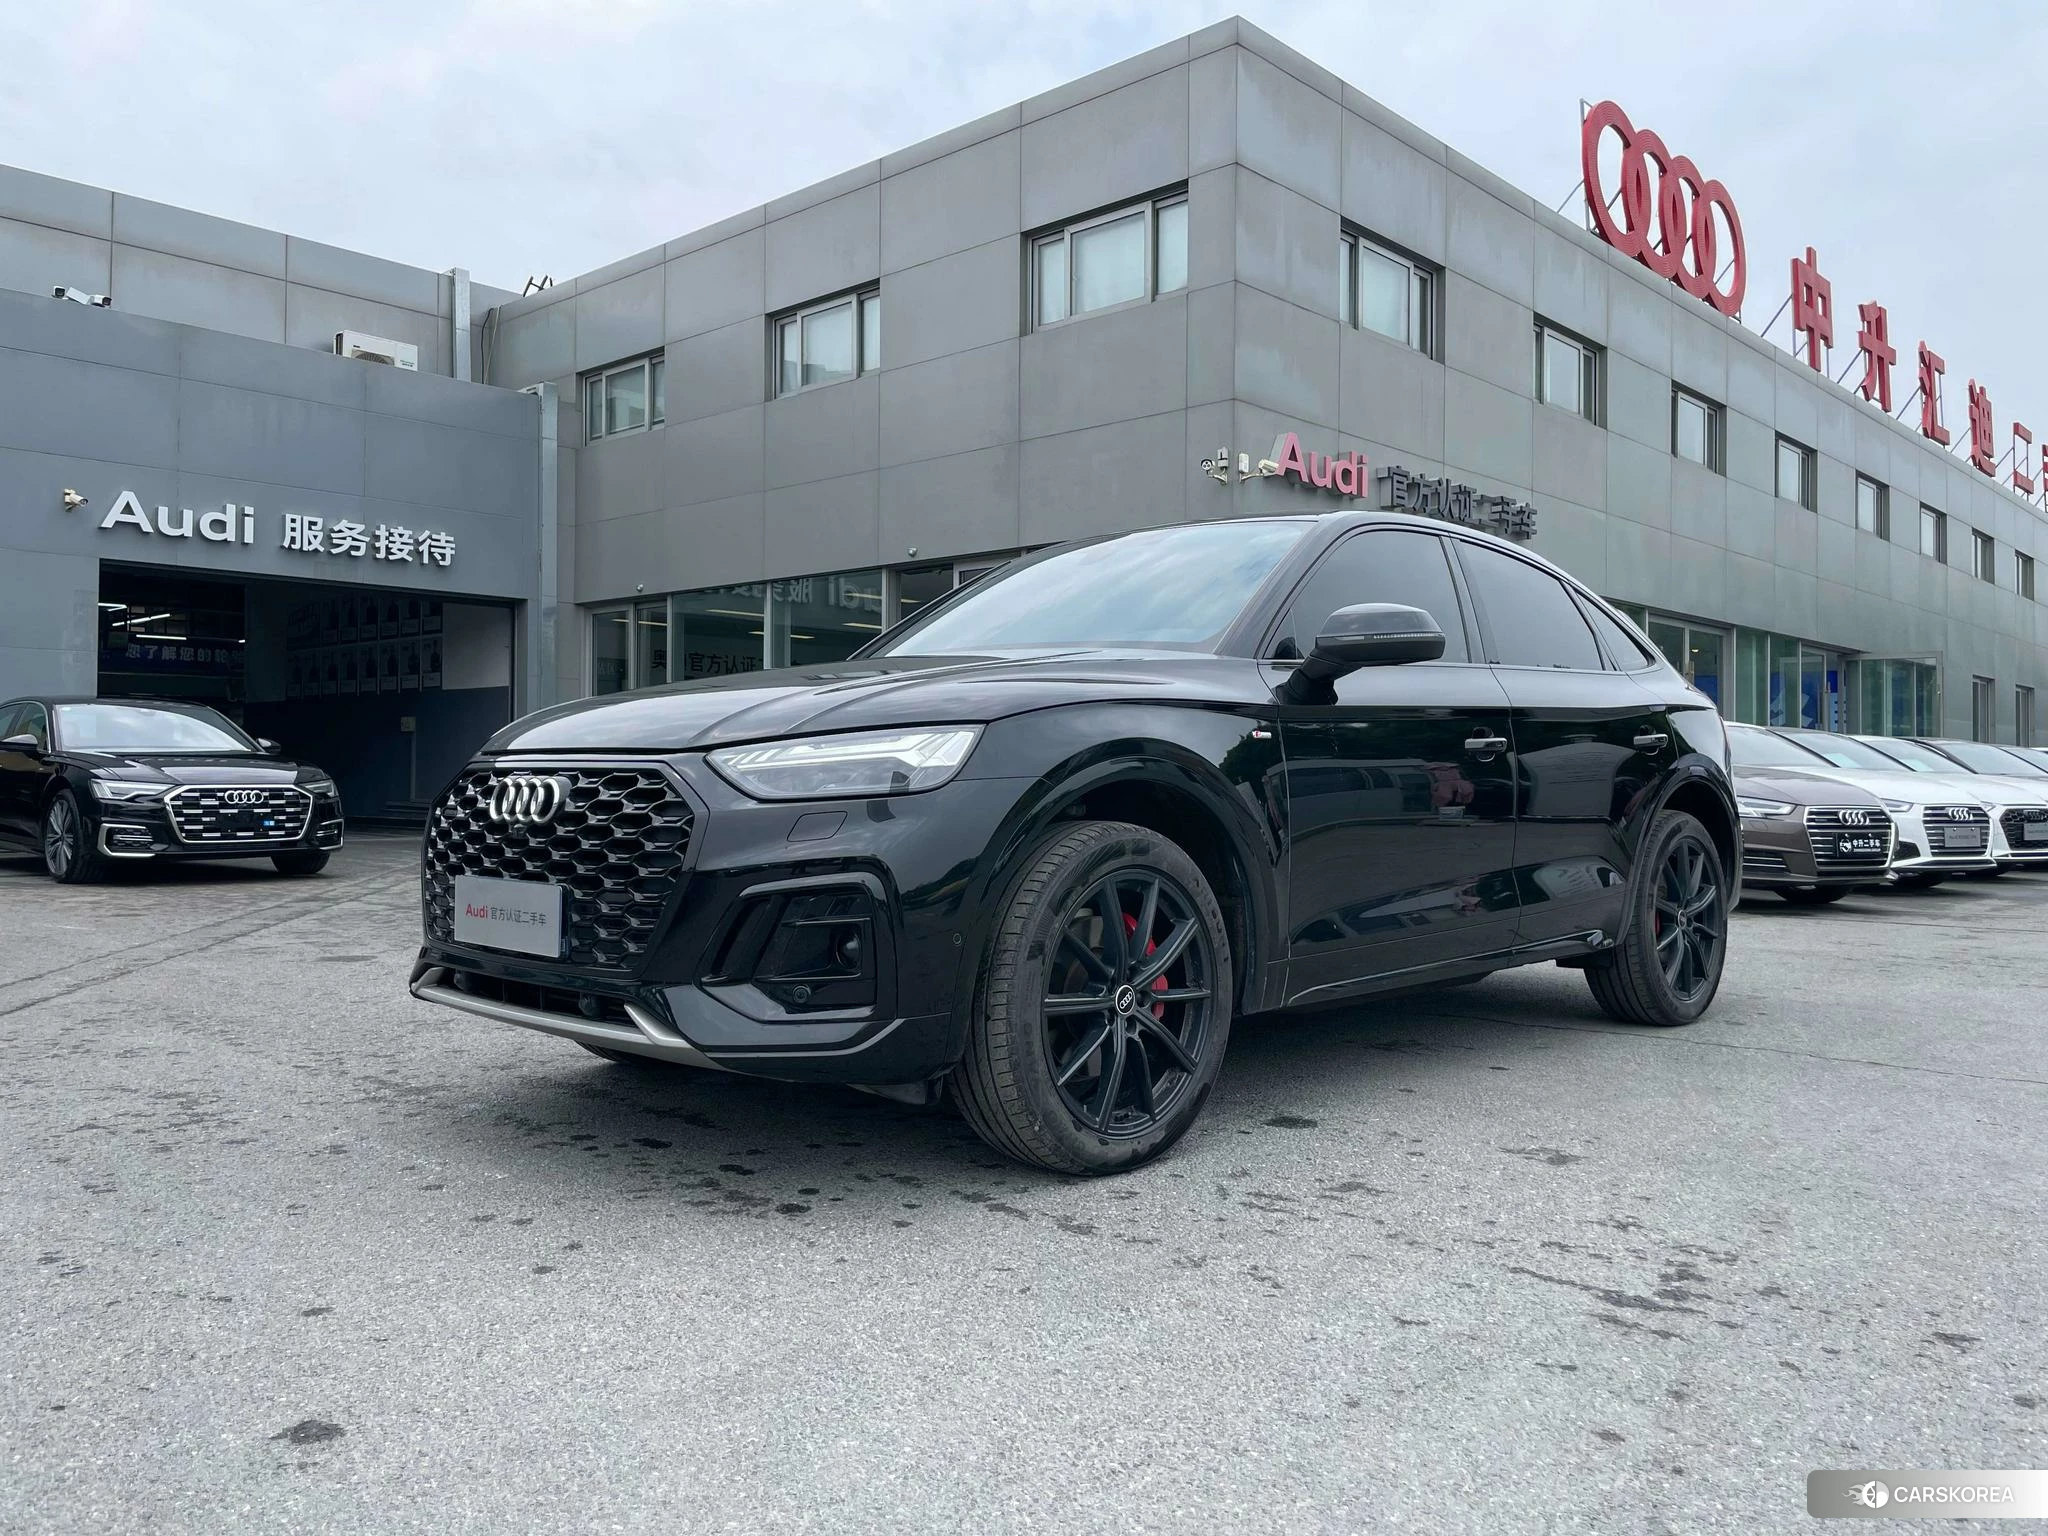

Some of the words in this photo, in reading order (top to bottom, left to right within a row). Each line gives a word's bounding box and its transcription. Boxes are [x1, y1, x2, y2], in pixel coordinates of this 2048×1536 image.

[1791, 246, 2048, 495] 中升汇迪二
[1276, 432, 1368, 498] Audi
[101, 490, 255, 545] Audi
[1378, 465, 1537, 540] 官方认证二手车
[282, 512, 457, 568] 服务接待
[465, 903, 488, 919] Audi
[490, 907, 547, 926] 官方认证二手车
